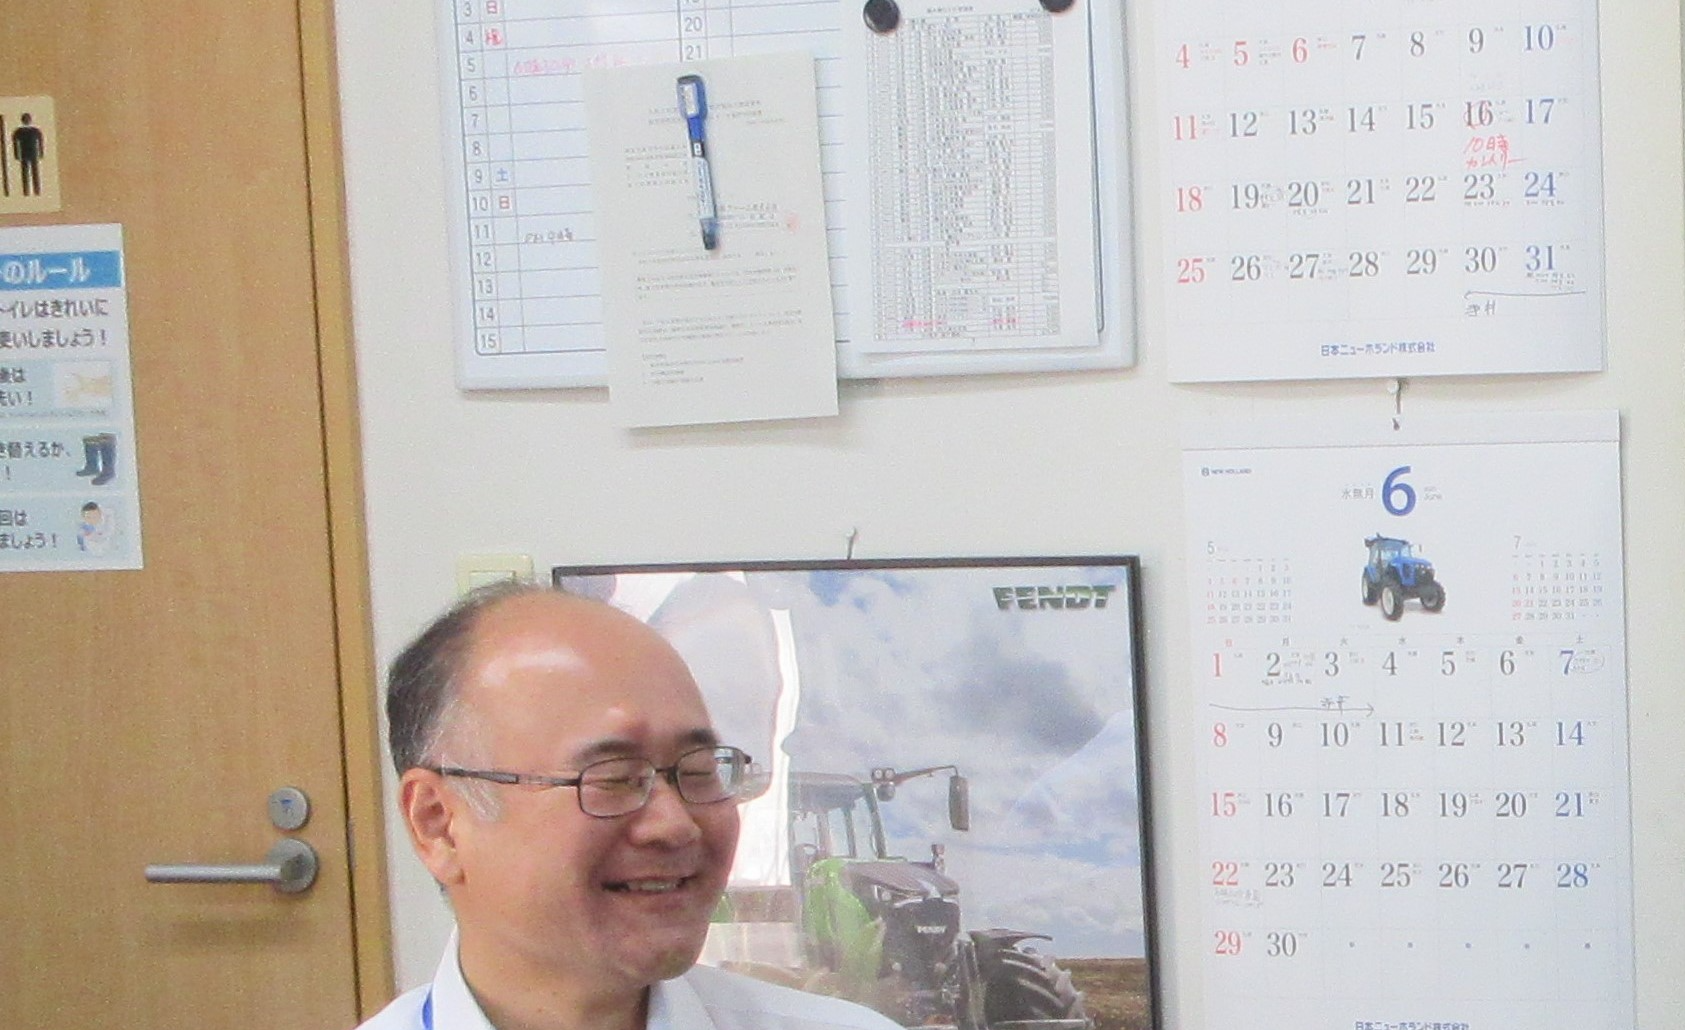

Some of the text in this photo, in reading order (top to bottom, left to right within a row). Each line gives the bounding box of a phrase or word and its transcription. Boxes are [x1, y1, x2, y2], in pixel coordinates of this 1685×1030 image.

[684, 17, 702, 32] 20
[465, 30, 473, 45] 4
[686, 45, 702, 60] 21
[1176, 26, 1553, 68] 4 5 6 7 8 9 10
[467, 58, 476, 73] 5
[469, 86, 477, 100] 6
[471, 114, 479, 128] 7
[1175, 98, 1554, 140] 11 12 13 14 15 16 17
[472, 141, 481, 156] 8
[474, 169, 483, 183] 9
[496, 168, 509, 182] 土
[1178, 172, 1555, 212] 18 19 20 21 22 23 24
[473, 197, 488, 211] 10
[499, 196, 510, 209] 日
[474, 225, 489, 239] 11
[476, 252, 491, 266] 12
[1178, 245, 1555, 284] 25 26 27 28 29 30 31
[2, 256, 91, 284] のルール
[478, 279, 493, 294] 13
[480, 307, 494, 321] 14
[481, 334, 496, 348] 15
[1320, 341, 1436, 357] 日本ニューホランド株式会社
[1382, 466, 1416, 516] 6
[1514, 535, 1521, 550] 7
[992, 585, 1116, 610] FENDT
[1576, 635, 1584, 644] 土
[1212, 650, 1574, 677] 1 2 3 4 5 6 7
[1214, 721, 1583, 747] 8 9 10 11 12 13 14
[1213, 792, 1582, 817] 15 16 17 18 19 20 21
[1212, 862, 1588, 888] 22 23 24 25 26 27 28
[1215, 931, 1296, 956] 29 30
